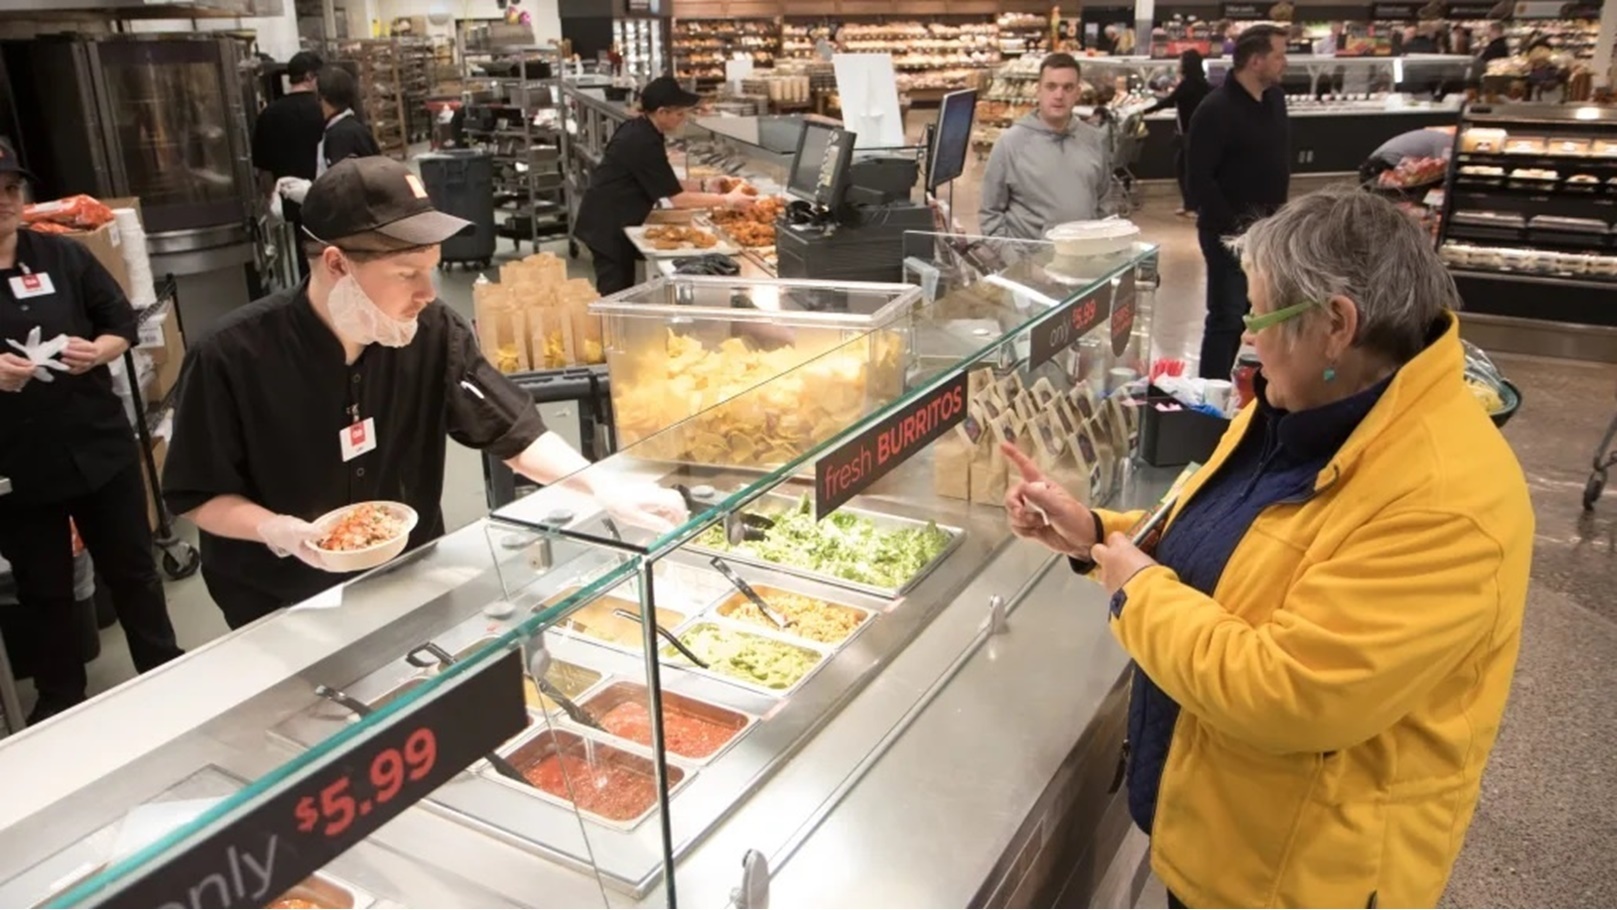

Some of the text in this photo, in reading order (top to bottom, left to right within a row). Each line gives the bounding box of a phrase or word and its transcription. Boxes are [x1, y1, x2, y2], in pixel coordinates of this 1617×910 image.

[825, 385, 962, 501] fresh BURRITOS
[157, 726, 437, 909] nly $5.99
